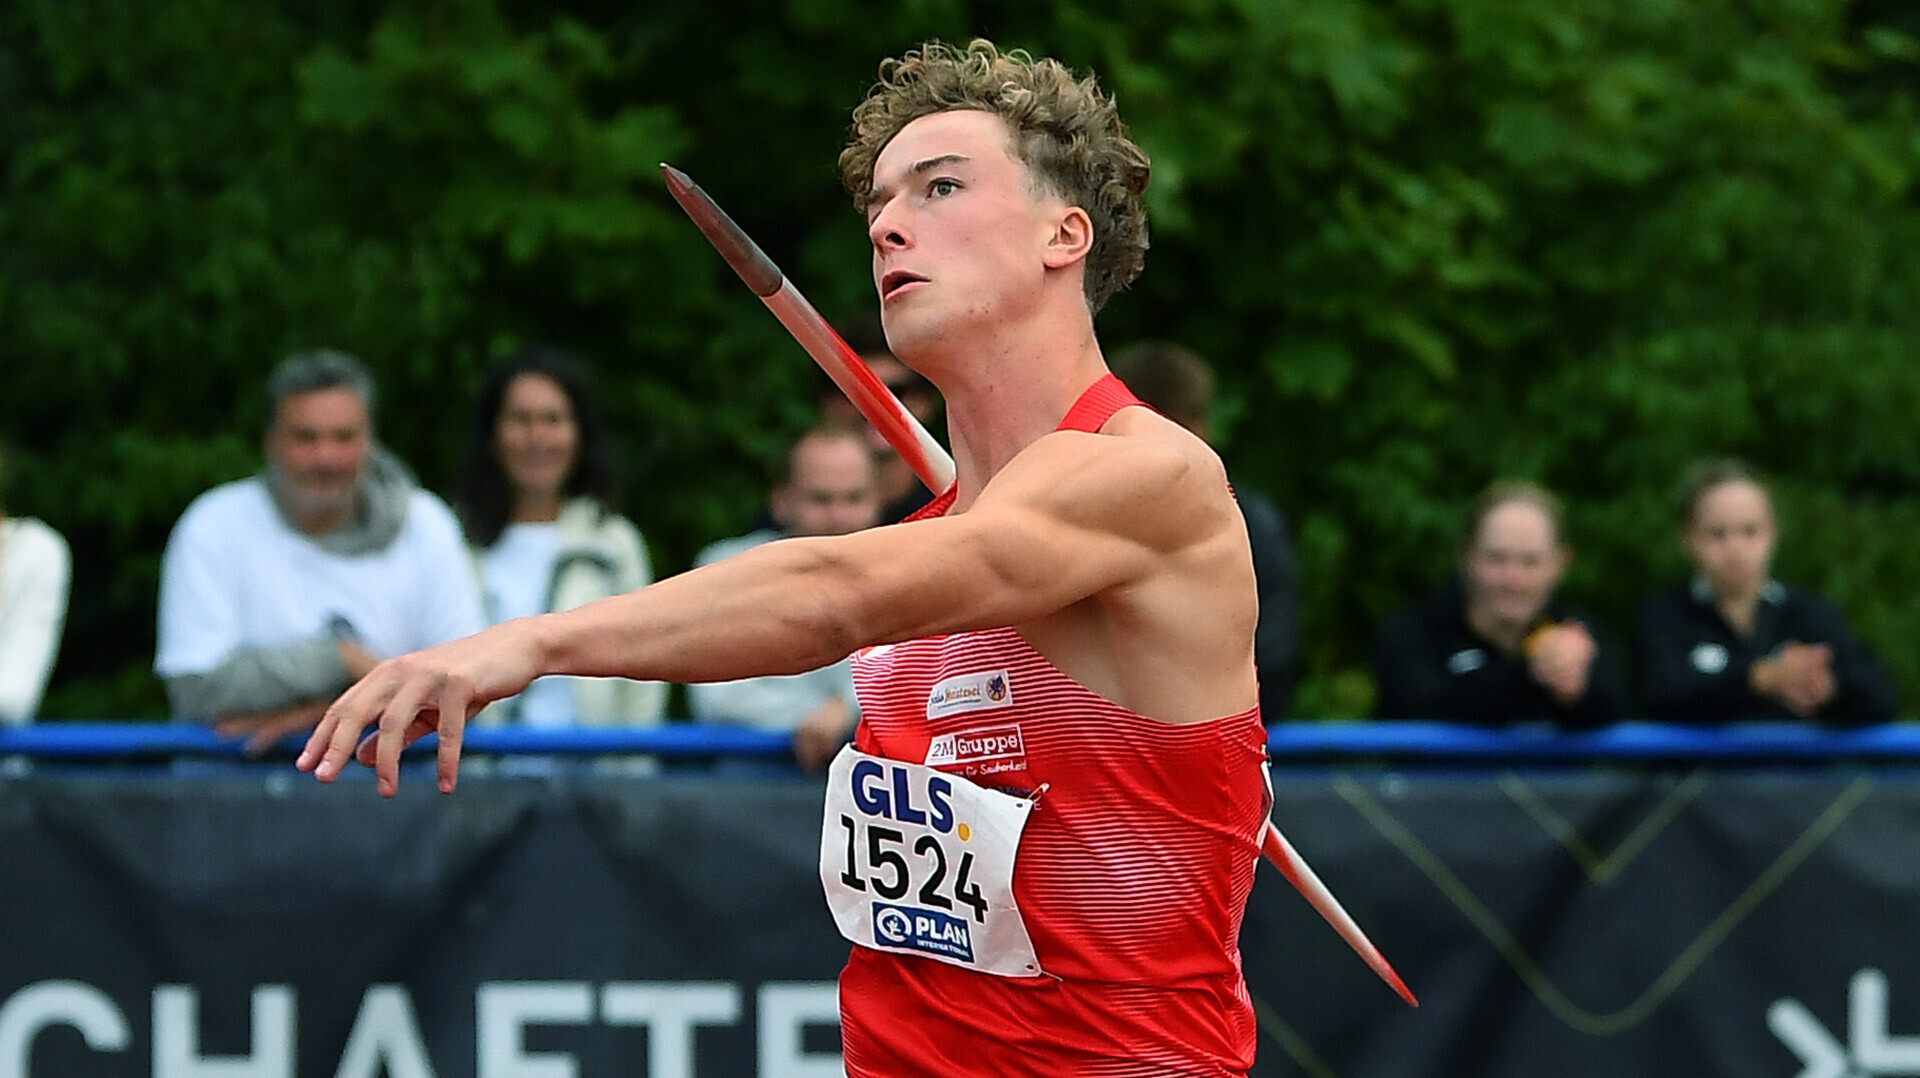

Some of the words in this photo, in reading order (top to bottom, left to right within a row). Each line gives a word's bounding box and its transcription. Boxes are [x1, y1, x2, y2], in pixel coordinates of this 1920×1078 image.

[931, 740, 954, 757] 2M
[957, 735, 1018, 755] Gruppe
[841, 814, 989, 924] 1524
[916, 916, 968, 948] PLAN
